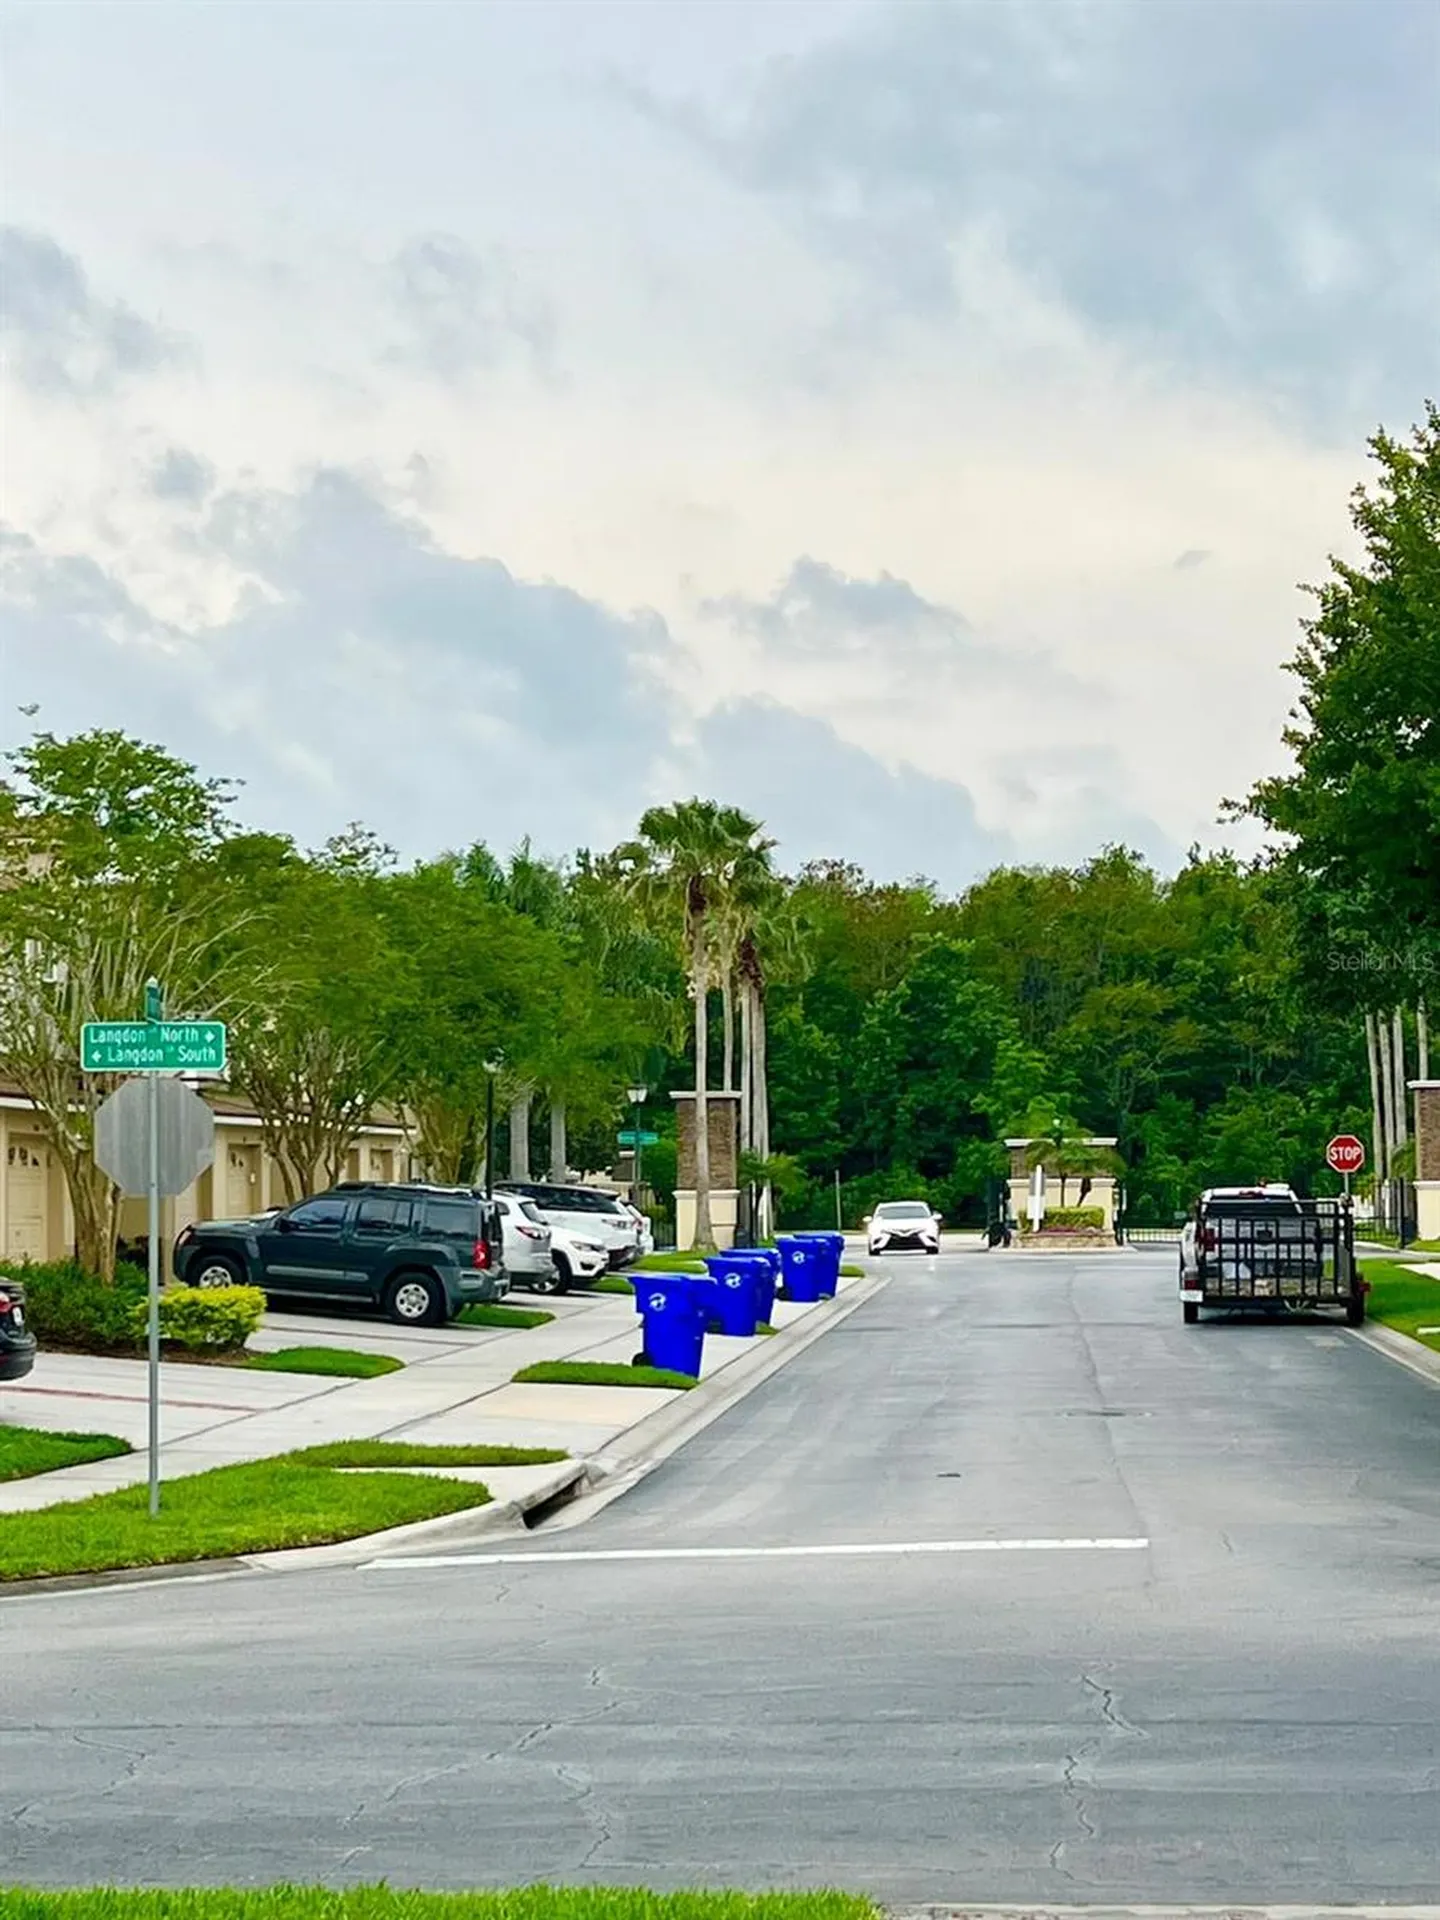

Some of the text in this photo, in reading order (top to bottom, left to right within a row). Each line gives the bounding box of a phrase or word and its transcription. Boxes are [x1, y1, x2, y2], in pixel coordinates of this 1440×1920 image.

[89, 1026, 199, 1046] Langdon North
[107, 1046, 164, 1064] Langdon
[177, 1045, 216, 1063] South
[1330, 1145, 1362, 1161] STOP
